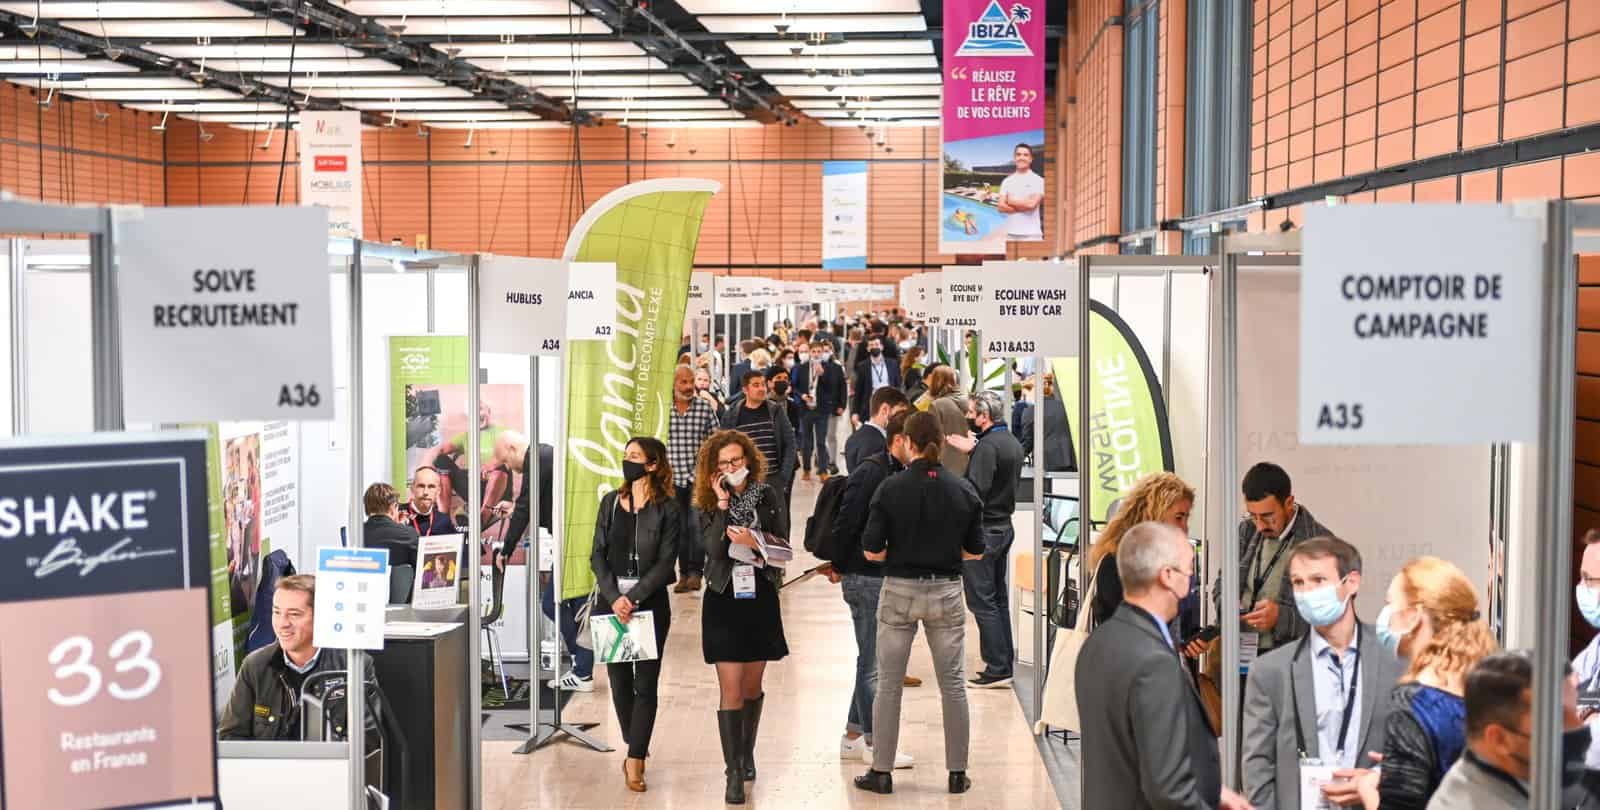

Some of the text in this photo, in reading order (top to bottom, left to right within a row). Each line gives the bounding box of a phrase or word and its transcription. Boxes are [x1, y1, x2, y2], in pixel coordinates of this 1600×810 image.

[971, 23, 1018, 38] IBIZA
[972, 68, 1016, 83] RÉALISEZ
[971, 85, 1016, 102] LE RÊVE
[957, 106, 1031, 119] DE VOS CLIENTS
[193, 268, 256, 293] SOLVE
[1341, 275, 1503, 301] COMPTOIR DE
[567, 290, 595, 300] ANCIA
[950, 284, 976, 293] ECOLINE
[995, 289, 1067, 301] ECOLINE WASH
[505, 292, 543, 305] HUBLISS
[953, 294, 979, 303] BYE BUY
[153, 303, 298, 328] RECRUTEMENT
[999, 304, 1062, 316] BYE BUY CAR
[945, 318, 977, 327] A31&A33
[1353, 313, 1488, 339] CAMPAGNE
[595, 326, 612, 336] A32
[541, 339, 561, 351] A34
[988, 341, 1035, 353] A31&A33
[277, 383, 321, 407] A36
[633, 379, 648, 431] SPORT
[1317, 403, 1363, 430] A35
[48, 629, 162, 707] 33
[60, 725, 156, 752] Restaurants
[70, 751, 147, 774] en France
